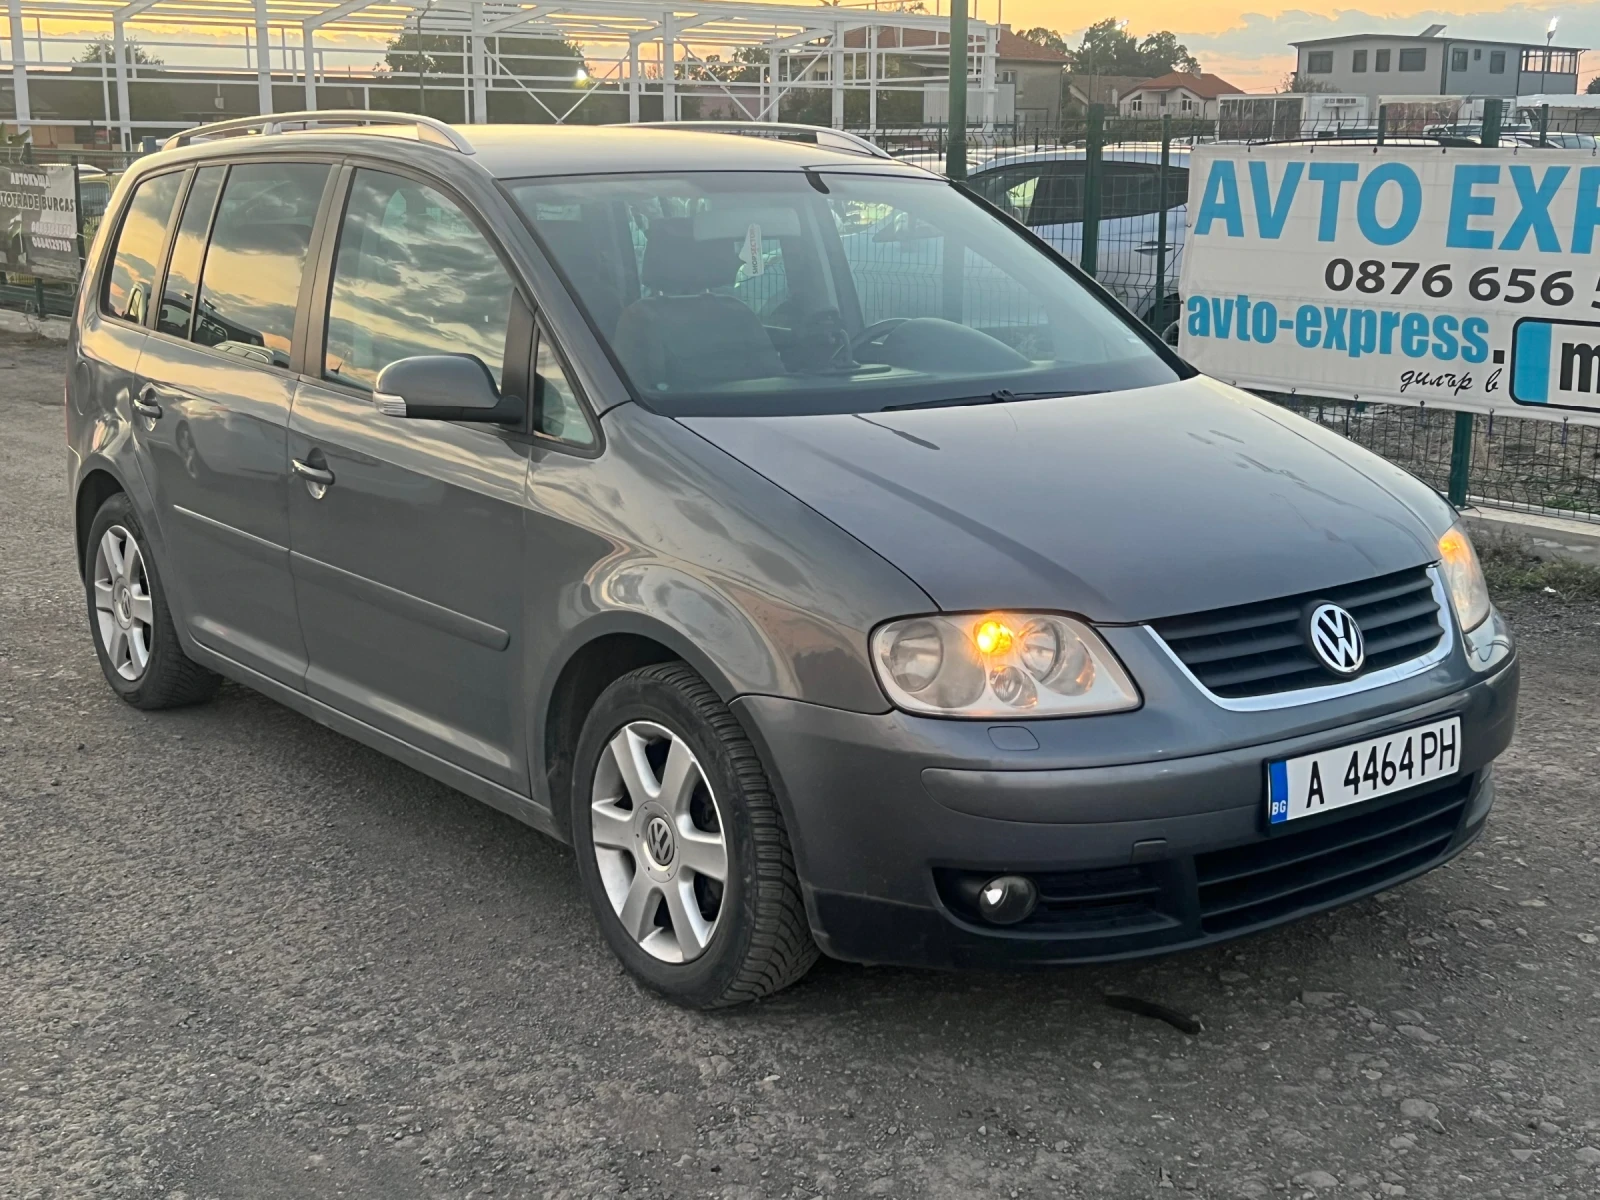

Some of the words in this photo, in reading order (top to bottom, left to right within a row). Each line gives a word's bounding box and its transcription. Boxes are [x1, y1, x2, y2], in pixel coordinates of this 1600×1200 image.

[0, 191, 40, 210] TOTRADE
[1194, 160, 1422, 246] AVTO
[1325, 259, 1453, 297] 0876
[1469, 267, 1574, 306] 656
[1401, 371, 1473, 396] дилър
[1306, 761, 1325, 808] A
[1272, 800, 1288, 815] BG
